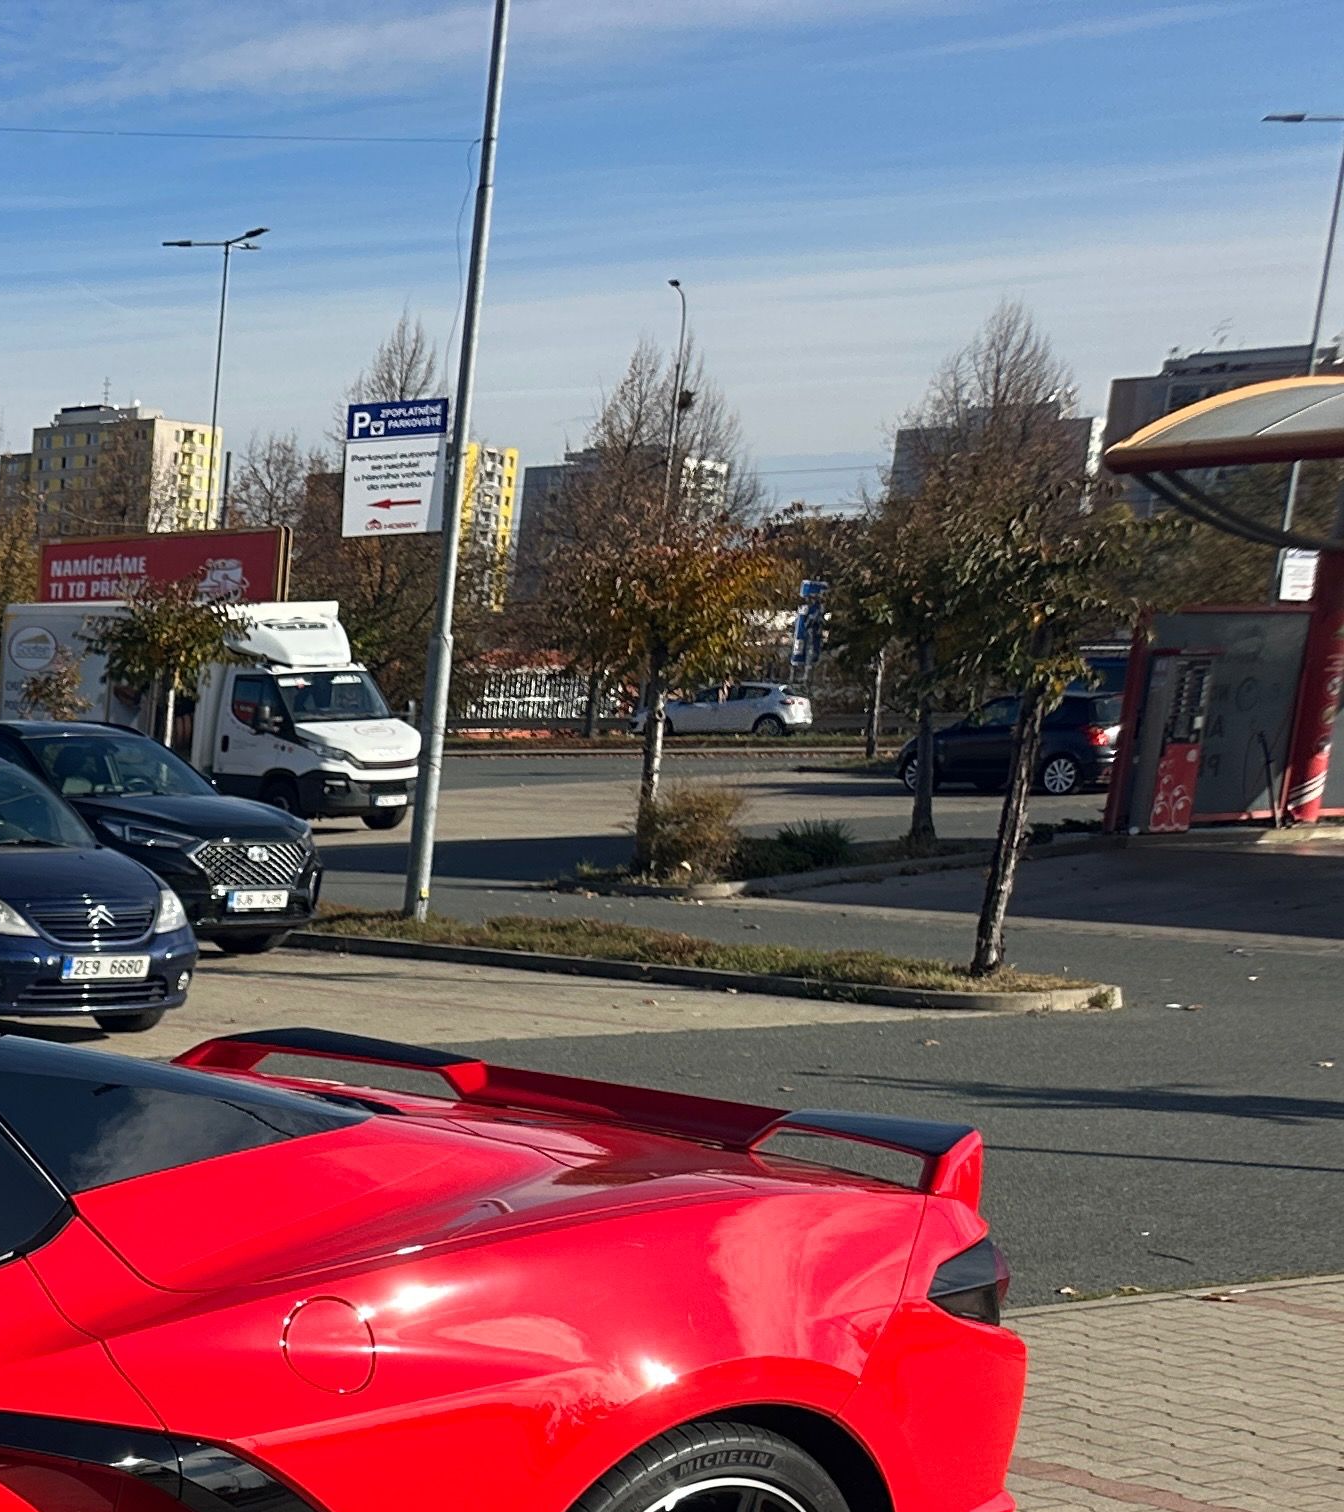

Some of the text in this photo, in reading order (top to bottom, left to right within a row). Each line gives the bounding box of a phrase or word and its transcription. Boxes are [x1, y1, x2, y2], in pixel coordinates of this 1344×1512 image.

[352, 411, 372, 438] P
[50, 553, 147, 578] NAMÍCHÁME
[50, 583, 63, 600] TI
[67, 582, 86, 599] TO
[73, 958, 145, 976] 2E9 6680
[679, 1450, 770, 1477] MICHELIN
